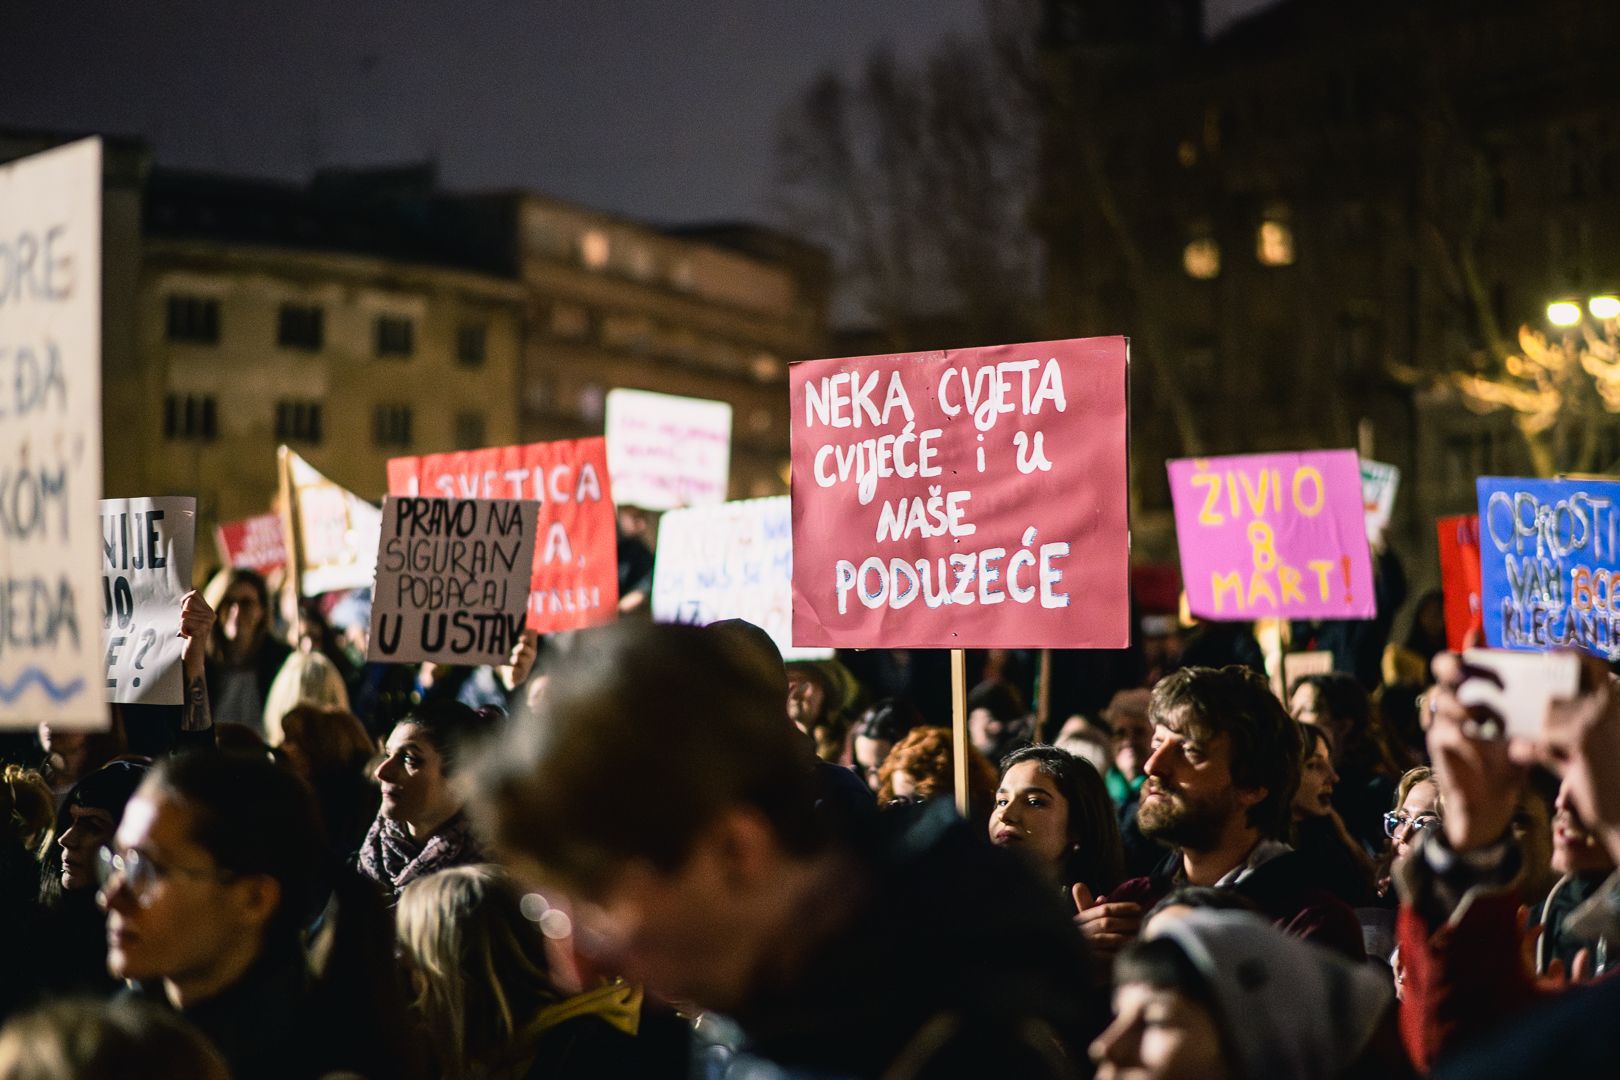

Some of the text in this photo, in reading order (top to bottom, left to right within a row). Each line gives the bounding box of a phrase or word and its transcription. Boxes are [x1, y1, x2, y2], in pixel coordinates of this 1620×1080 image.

[805, 358, 1066, 431] NEKA CVJETA
[396, 499, 523, 537] PRAVO NA
[876, 484, 976, 543] NAŠE
[1487, 491, 1615, 565] OPROSTI
[385, 539, 521, 576] SIGURAN
[836, 526, 1071, 614] PODUZEĆE
[1247, 521, 1276, 571] 8
[379, 610, 527, 655] U USTAV
